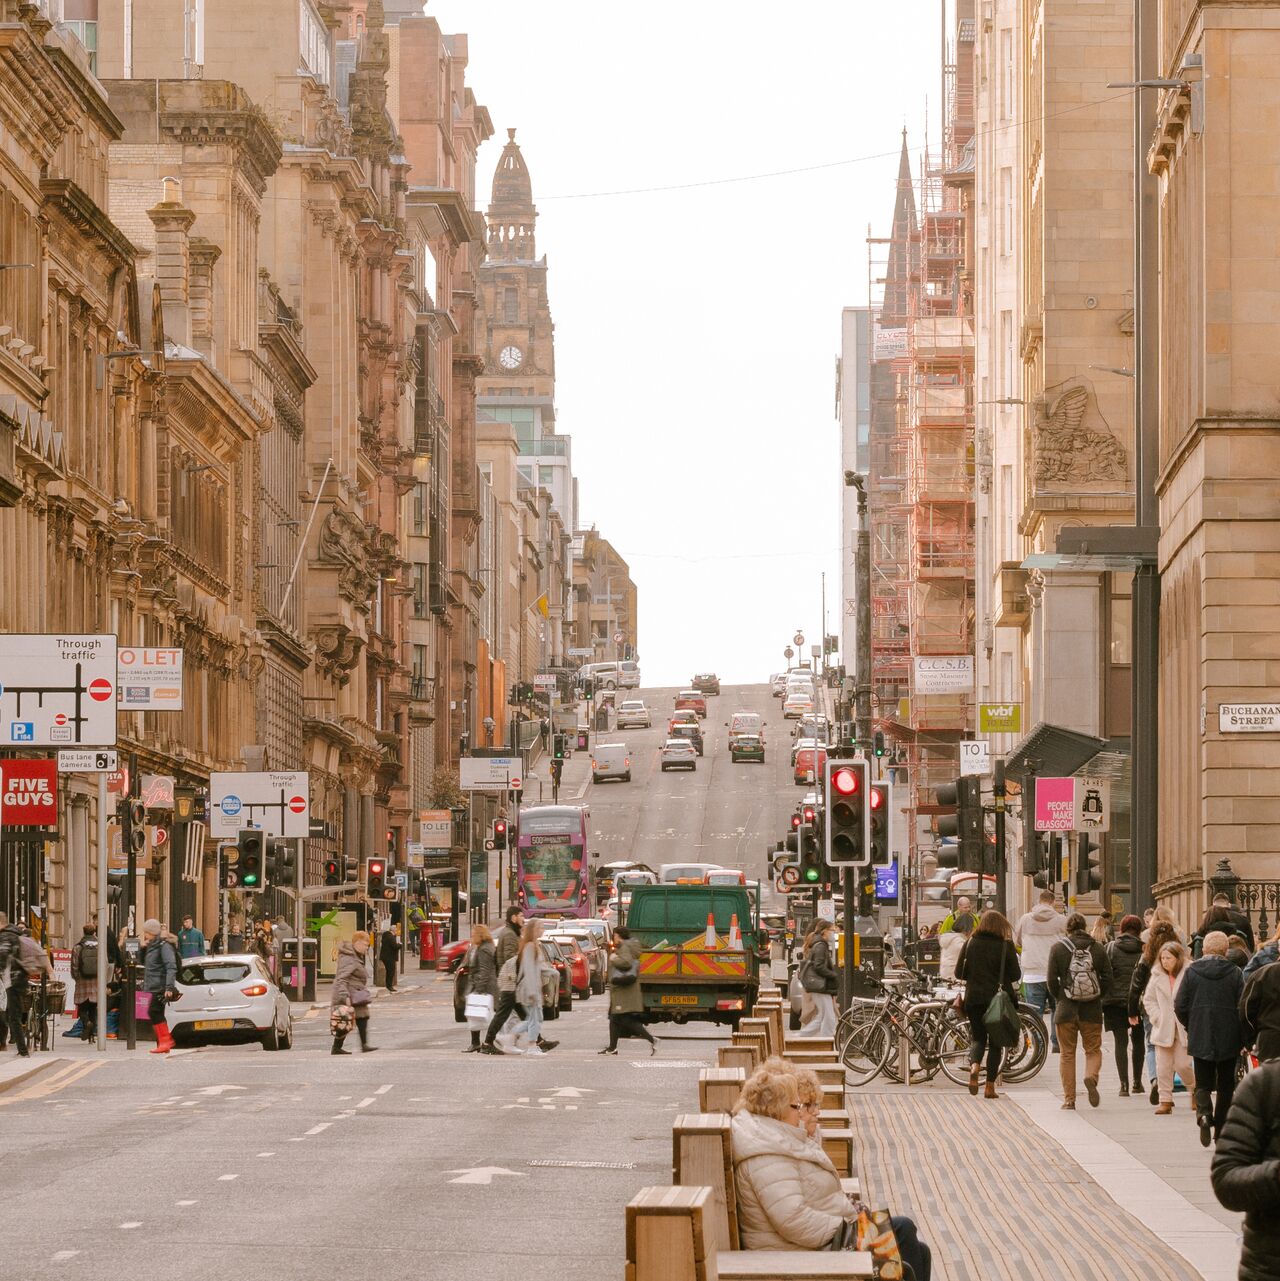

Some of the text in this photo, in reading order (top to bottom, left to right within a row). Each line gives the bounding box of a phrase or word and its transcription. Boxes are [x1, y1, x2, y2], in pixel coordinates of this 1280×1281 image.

[56, 639, 101, 650] Through
[62, 651, 96, 660] traffic
[143, 650, 180, 665] LET
[987, 707, 1013, 716] wbf
[1230, 716, 1274, 725] STREET
[14, 724, 26, 739] P
[963, 744, 979, 755] TO
[76, 753, 92, 761] lane
[9, 779, 49, 791] FIVE
[4, 792, 53, 806] GUYS
[1047, 802, 1072, 810] PEOPLE
[1052, 811, 1072, 819] MAKE
[1037, 820, 1072, 829] GLASGOW
